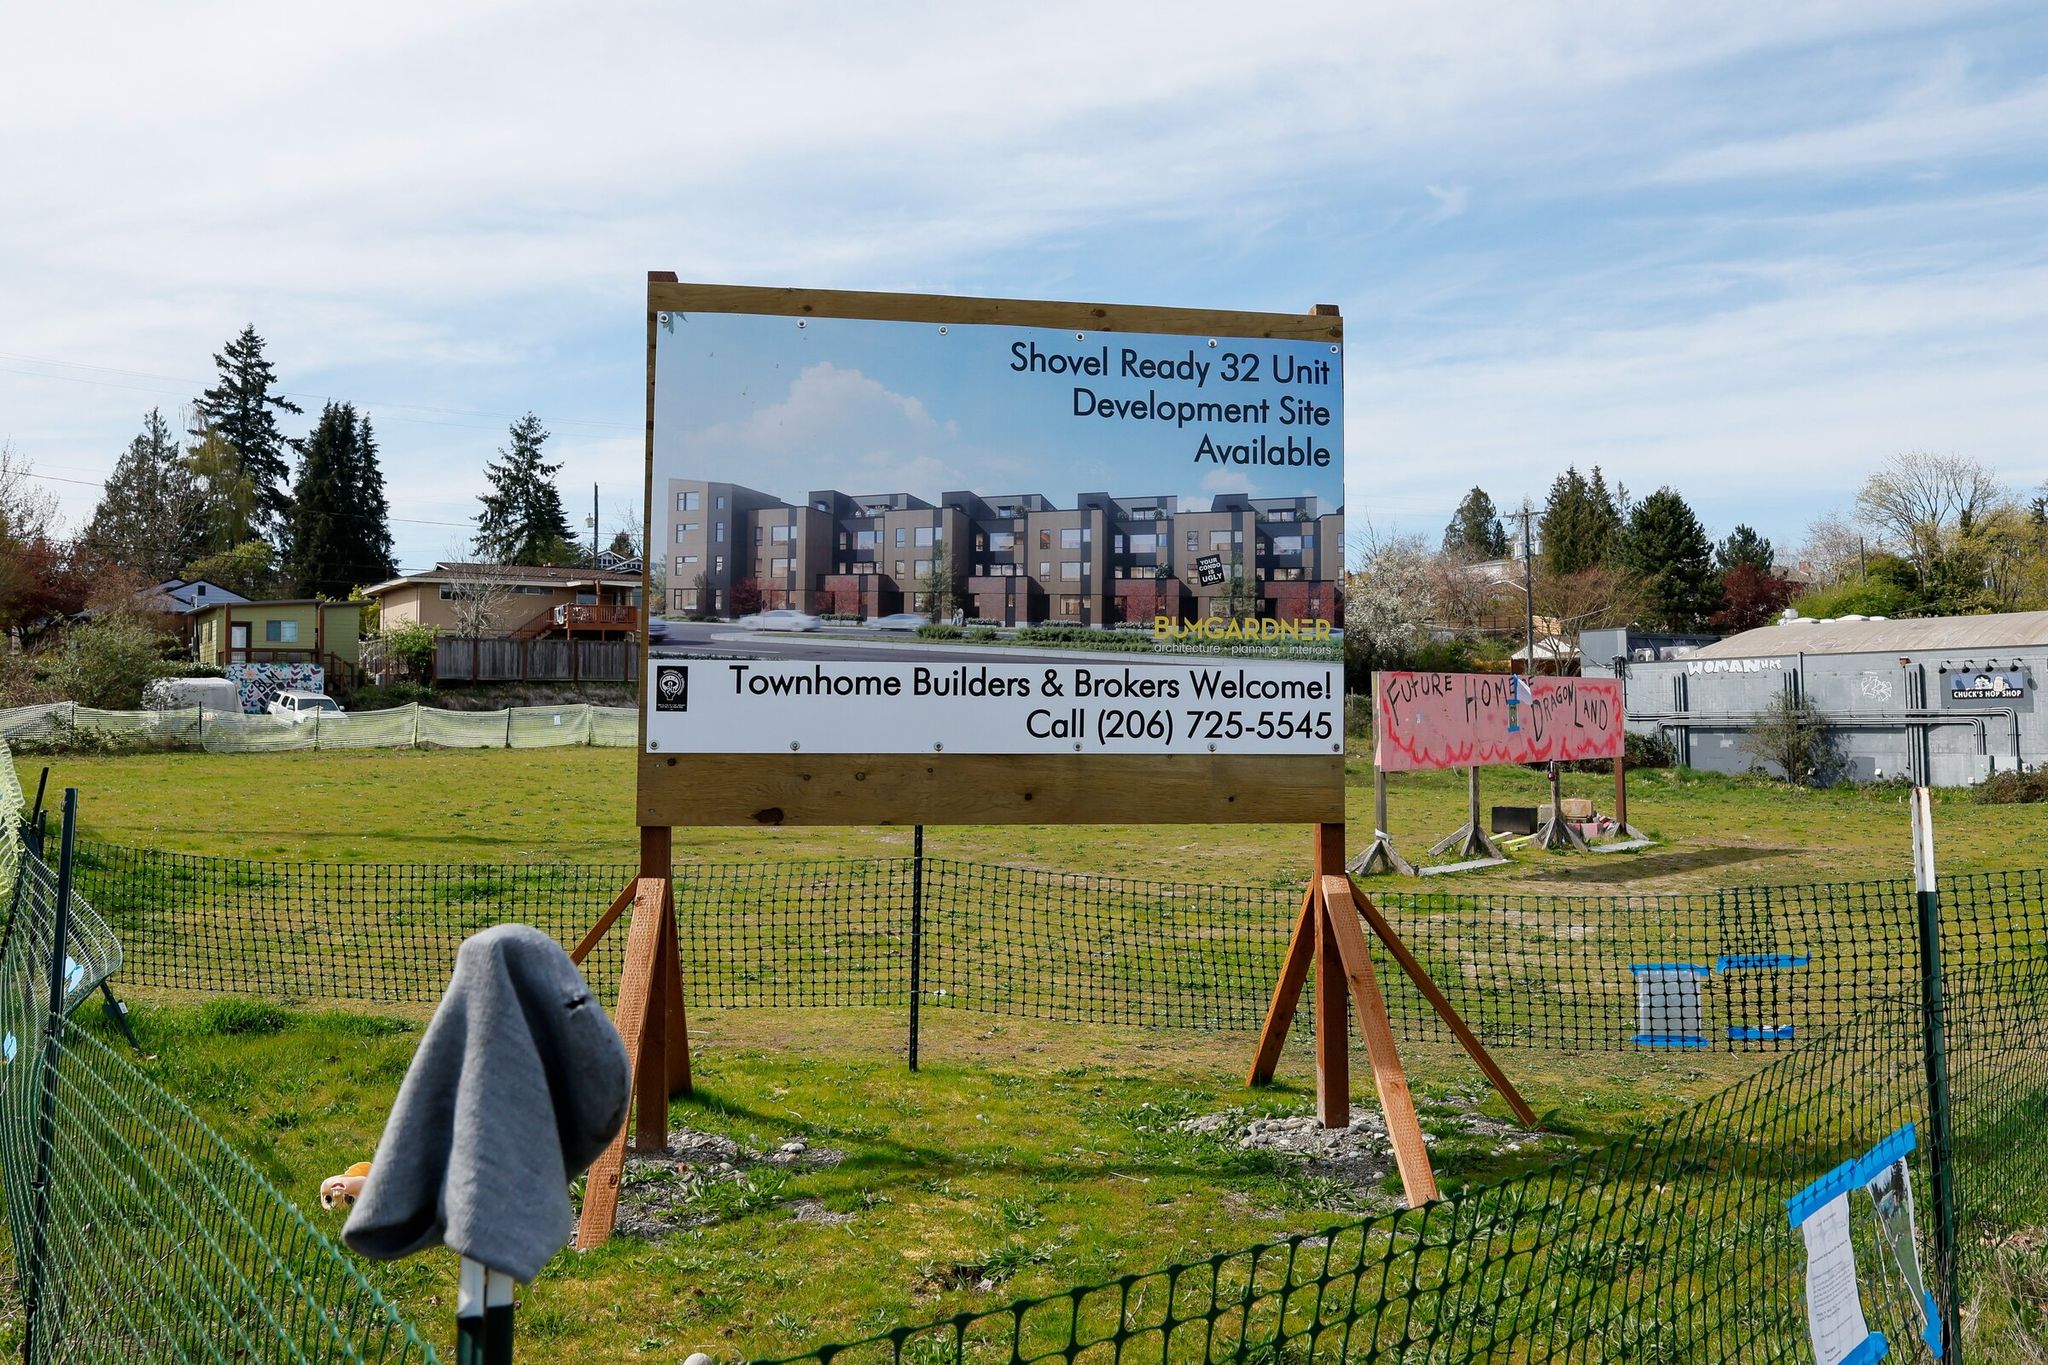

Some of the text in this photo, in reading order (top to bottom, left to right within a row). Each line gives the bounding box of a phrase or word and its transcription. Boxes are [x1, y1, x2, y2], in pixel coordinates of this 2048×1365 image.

[1010, 342, 1330, 388] Shovel Ready 32 Unit
[1073, 387, 1331, 428] Development Site
[1194, 433, 1331, 467] Available
[1199, 562, 1221, 571] CONDO
[1200, 557, 1217, 566] YOUR
[1202, 572, 1222, 583] UGLY
[1154, 616, 1331, 642] BUMGARDNER
[1154, 643, 1332, 656] architecture planning interiors
[1687, 660, 1761, 676] WOMAN
[252, 670, 280, 694] BLM
[729, 664, 1332, 700] Townhome Builders & Brokers Welcome!
[1953, 690, 1984, 698] CHUCK'S
[1985, 690, 2000, 698] HOP
[1464, 675, 1514, 723] HOME
[1530, 680, 1574, 742] DRAGON
[1573, 685, 1608, 731] LAND
[1026, 708, 1333, 746] Call (206) 725-5545
